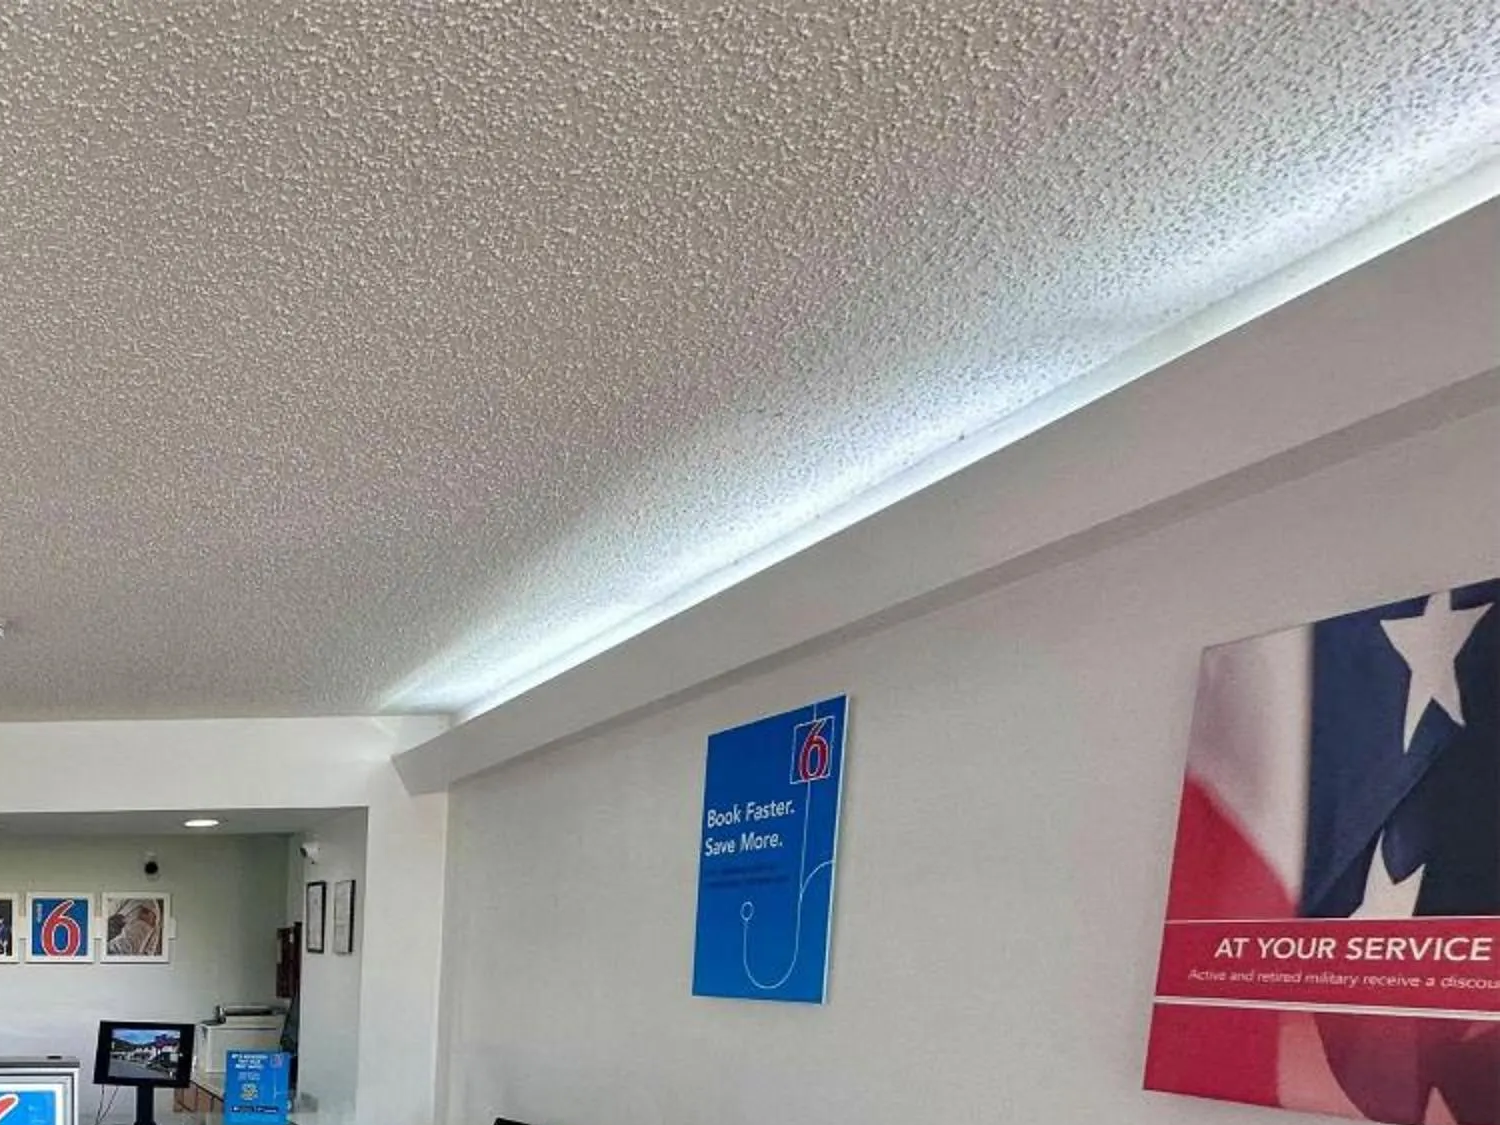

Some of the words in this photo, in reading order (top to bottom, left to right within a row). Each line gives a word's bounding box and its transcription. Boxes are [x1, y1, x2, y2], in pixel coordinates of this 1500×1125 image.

[799, 719, 829, 781] 6
[707, 804, 741, 828] Book
[745, 799, 796, 822] Faster.
[704, 837, 736, 857] Save
[739, 831, 784, 854] More.
[41, 899, 81, 957] 6
[1214, 937, 1250, 959] AT
[1257, 936, 1337, 960] YOUR
[1345, 937, 1493, 961] SERVICE
[1187, 967, 1227, 982] Active
[1230, 969, 1254, 982] and
[1258, 969, 1303, 984] retired
[1304, 971, 1359, 988] military
[1362, 972, 1421, 988] receive
[1425, 977, 1436, 987] a
